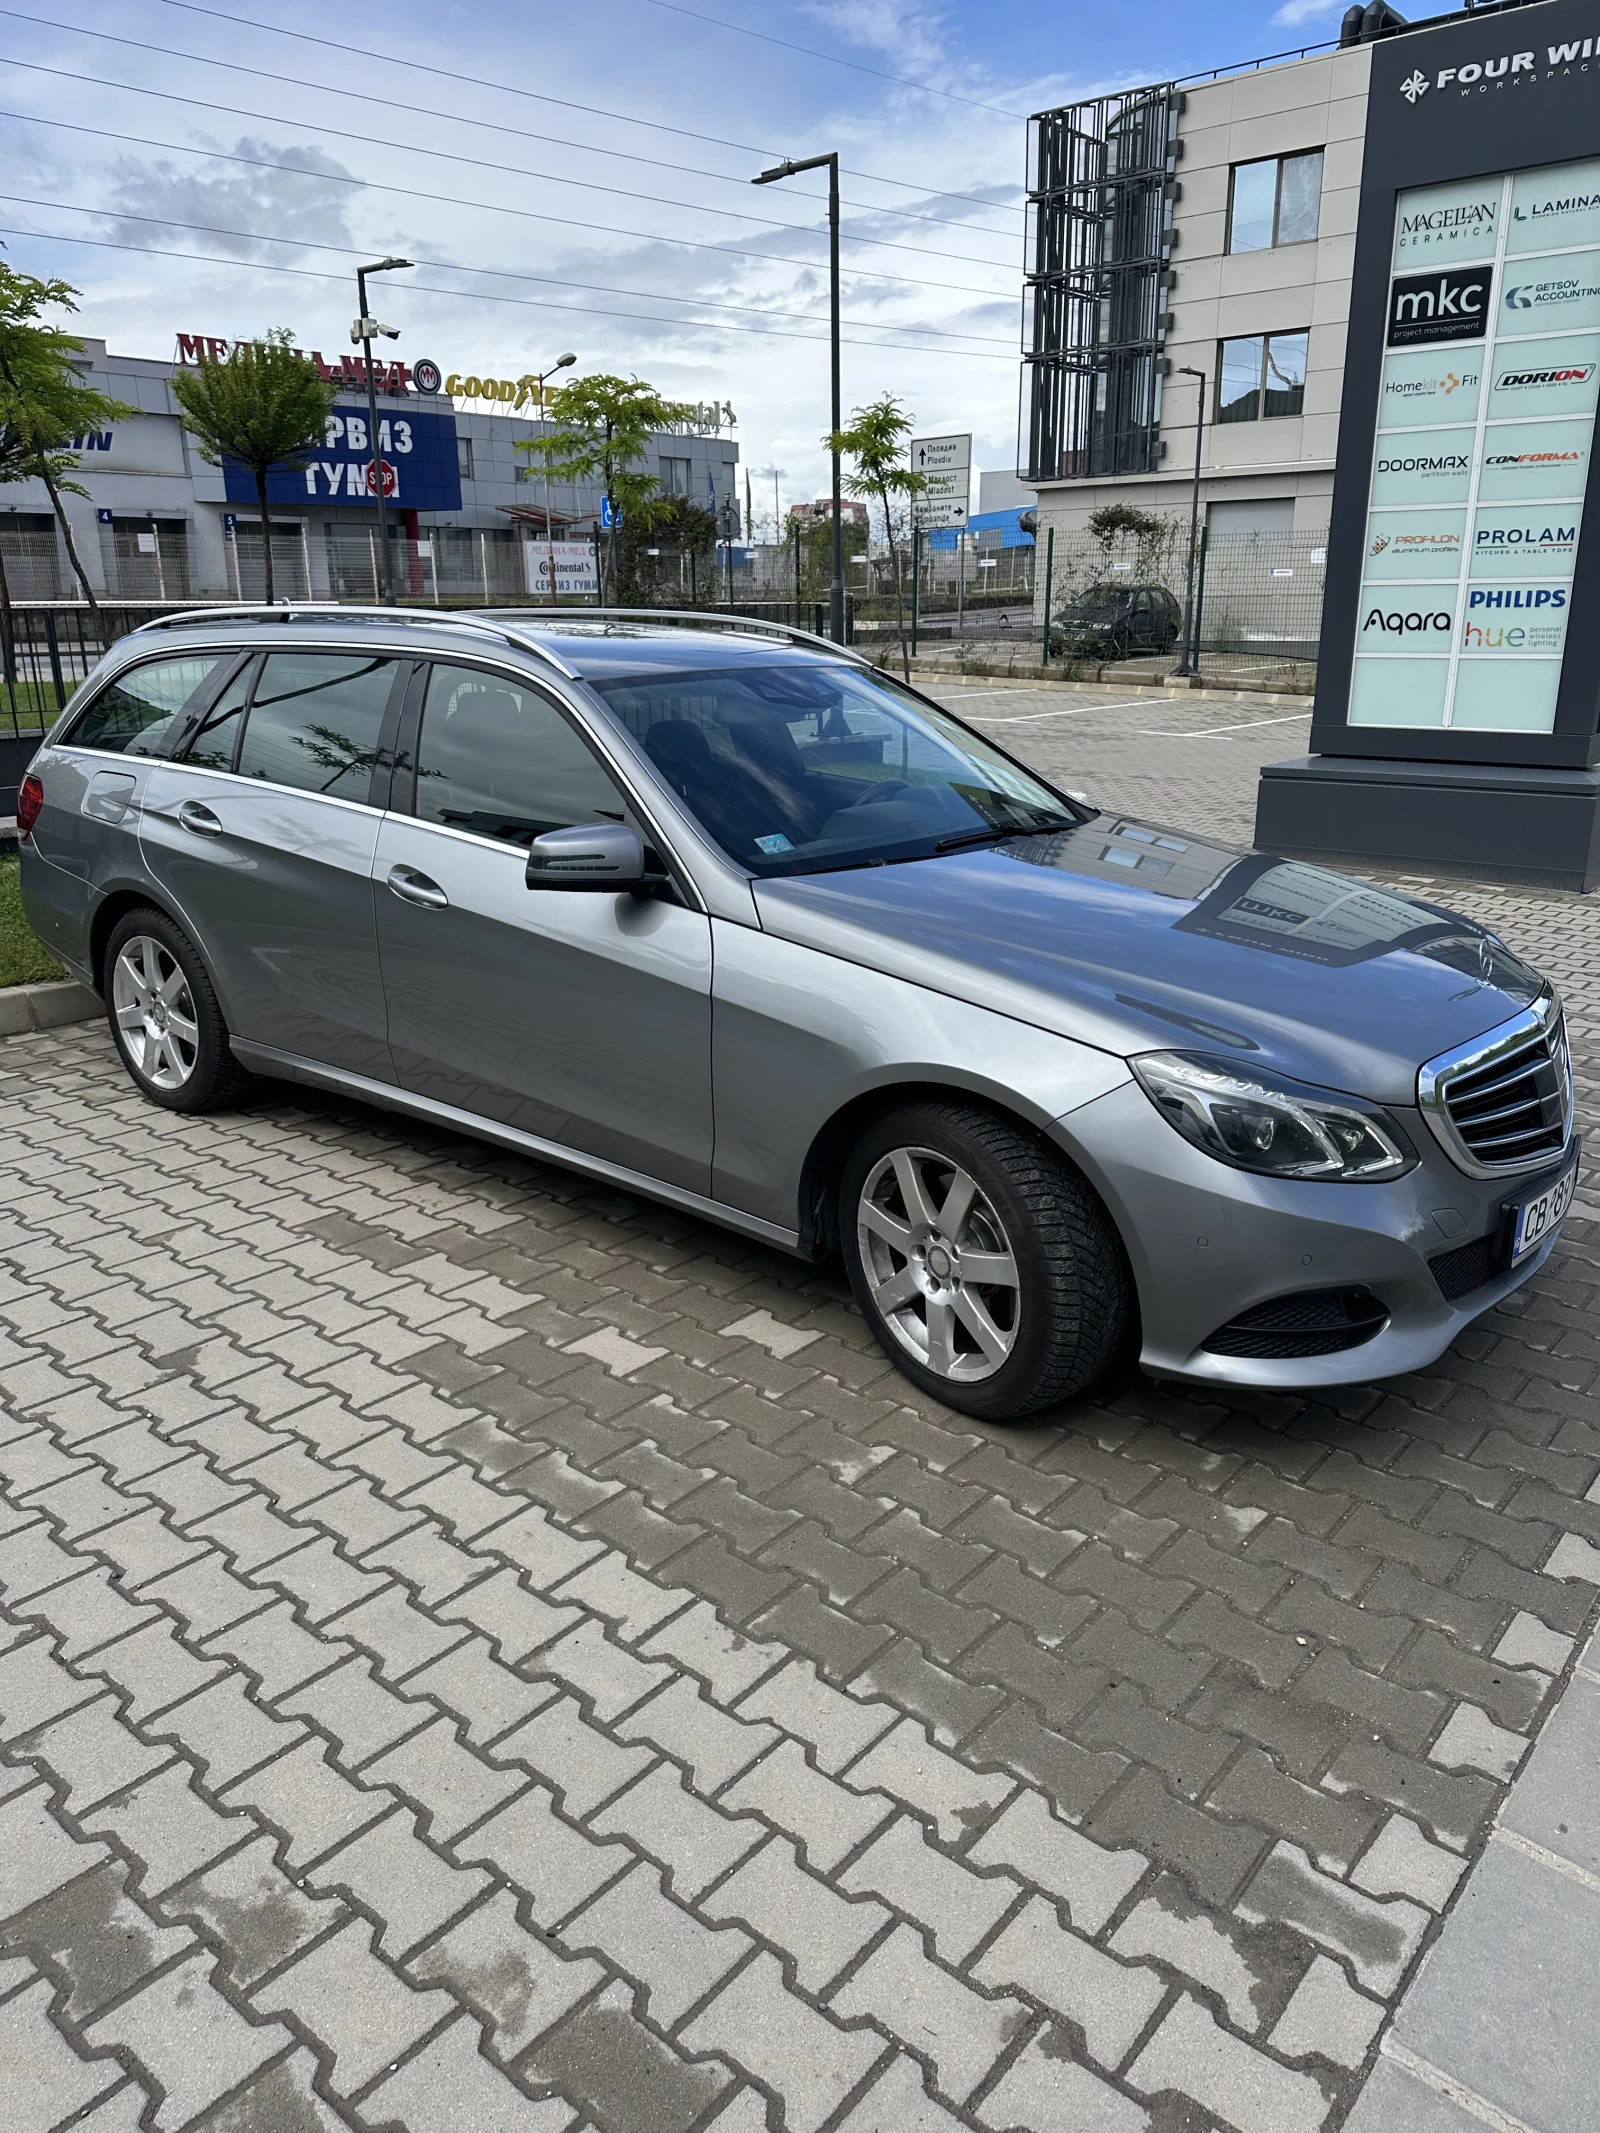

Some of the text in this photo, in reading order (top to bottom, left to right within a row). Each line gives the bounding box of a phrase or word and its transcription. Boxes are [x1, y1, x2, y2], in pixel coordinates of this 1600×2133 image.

[1437, 36, 1600, 89] FOUR WI
[1461, 62, 1600, 97] WORKSPAC
[1532, 194, 1600, 215] LAMINA
[1401, 202, 1497, 234] MAGELLAN
[1399, 225, 1494, 247] CERAMICA
[1536, 279, 1579, 292] GETSOV
[1396, 279, 1483, 320] mkc
[1394, 322, 1480, 340] project management
[1385, 374, 1479, 393] Homekit Fit
[1501, 368, 1588, 386] DORION
[927, 444, 957, 453] Пловдив
[927, 455, 952, 465] Plovdiv
[1378, 455, 1469, 472] DOORMAX
[1486, 451, 1579, 464] CONFORMA
[369, 471, 392, 485] SOP
[1421, 471, 1449, 479] partition
[928, 485, 954, 495] Mladost
[102, 511, 108, 520] 4
[228, 516, 233, 525] 5
[1395, 534, 1460, 544] PROFILON
[1477, 527, 1576, 544] PROLAM
[1469, 589, 1566, 608] PHILIPS
[1363, 609, 1451, 635] Aqara
[1529, 625, 1562, 633] personal
[1464, 621, 1525, 648] hue
[1528, 639, 1558, 647] lighting
